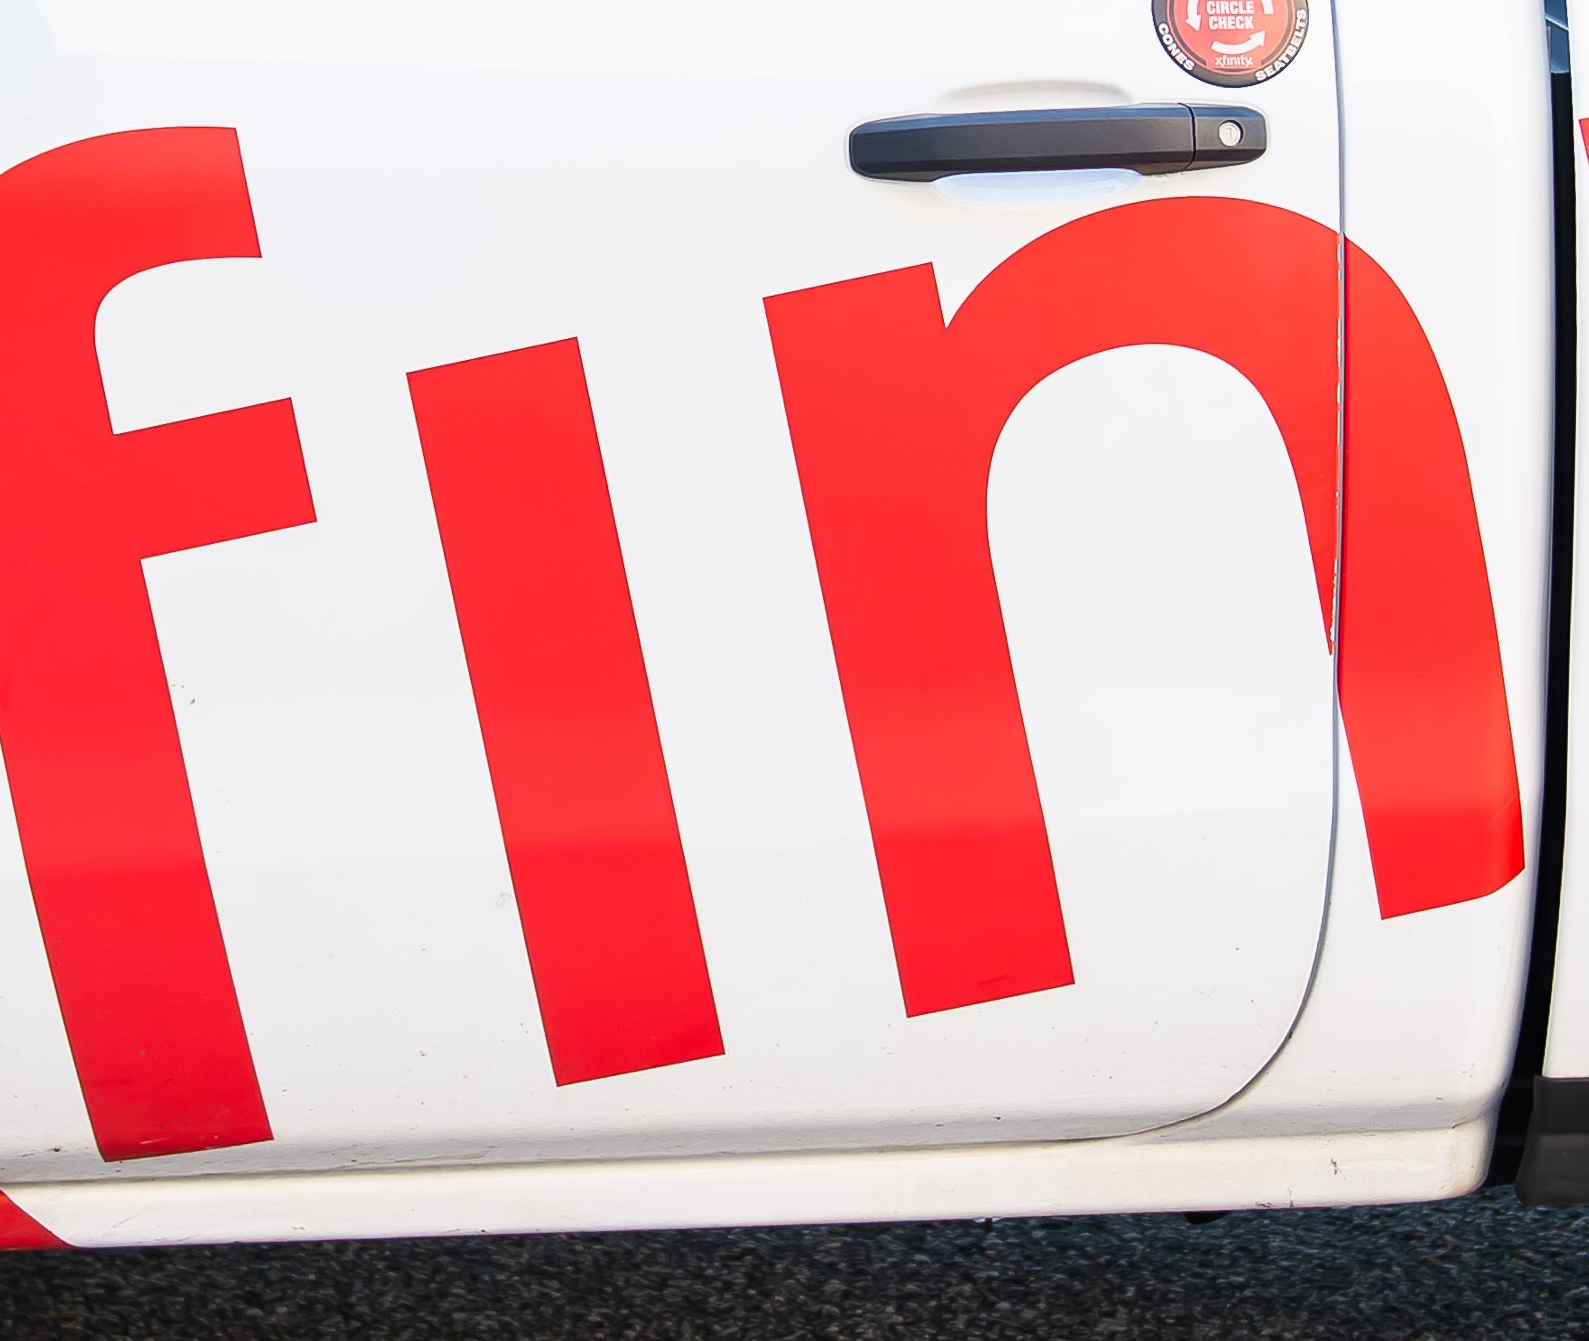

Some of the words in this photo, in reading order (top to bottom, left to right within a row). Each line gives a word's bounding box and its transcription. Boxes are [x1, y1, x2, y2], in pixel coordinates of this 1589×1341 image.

[1206, 0, 1255, 15] CIRCLE
[1208, 15, 1254, 30] CHECK
[1158, 23, 1195, 72] CONES
[1255, 8, 1307, 82] SEATBELTS
[1214, 55, 1254, 67] xfinity
